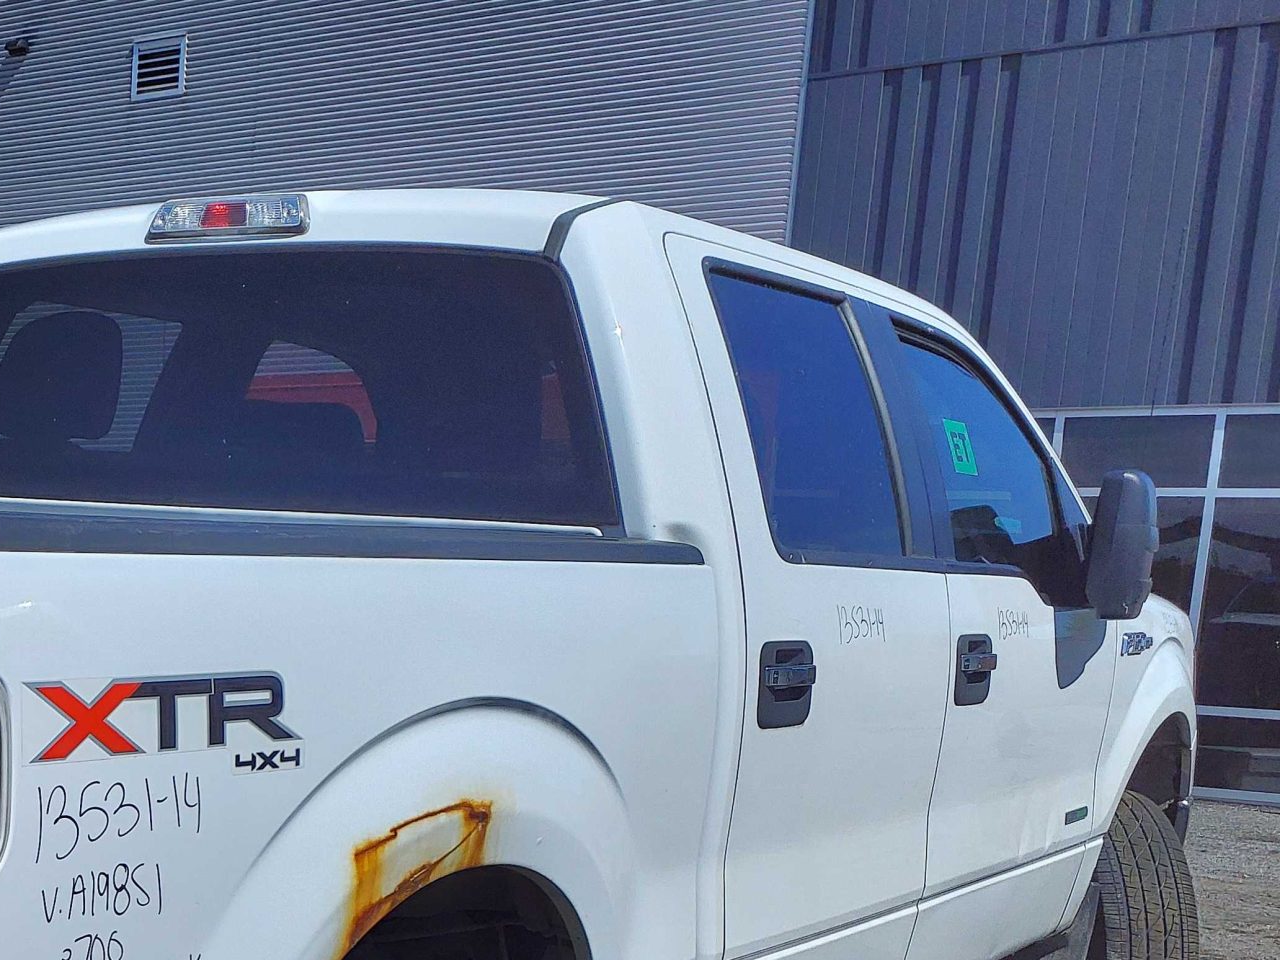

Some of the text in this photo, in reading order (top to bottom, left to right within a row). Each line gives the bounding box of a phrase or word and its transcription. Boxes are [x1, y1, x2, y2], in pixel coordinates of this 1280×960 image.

[836, 603, 887, 645] 13531-14
[996, 606, 1030, 641] 13531-14
[22, 671, 304, 764] XTR
[35, 772, 202, 864] 13531-14
